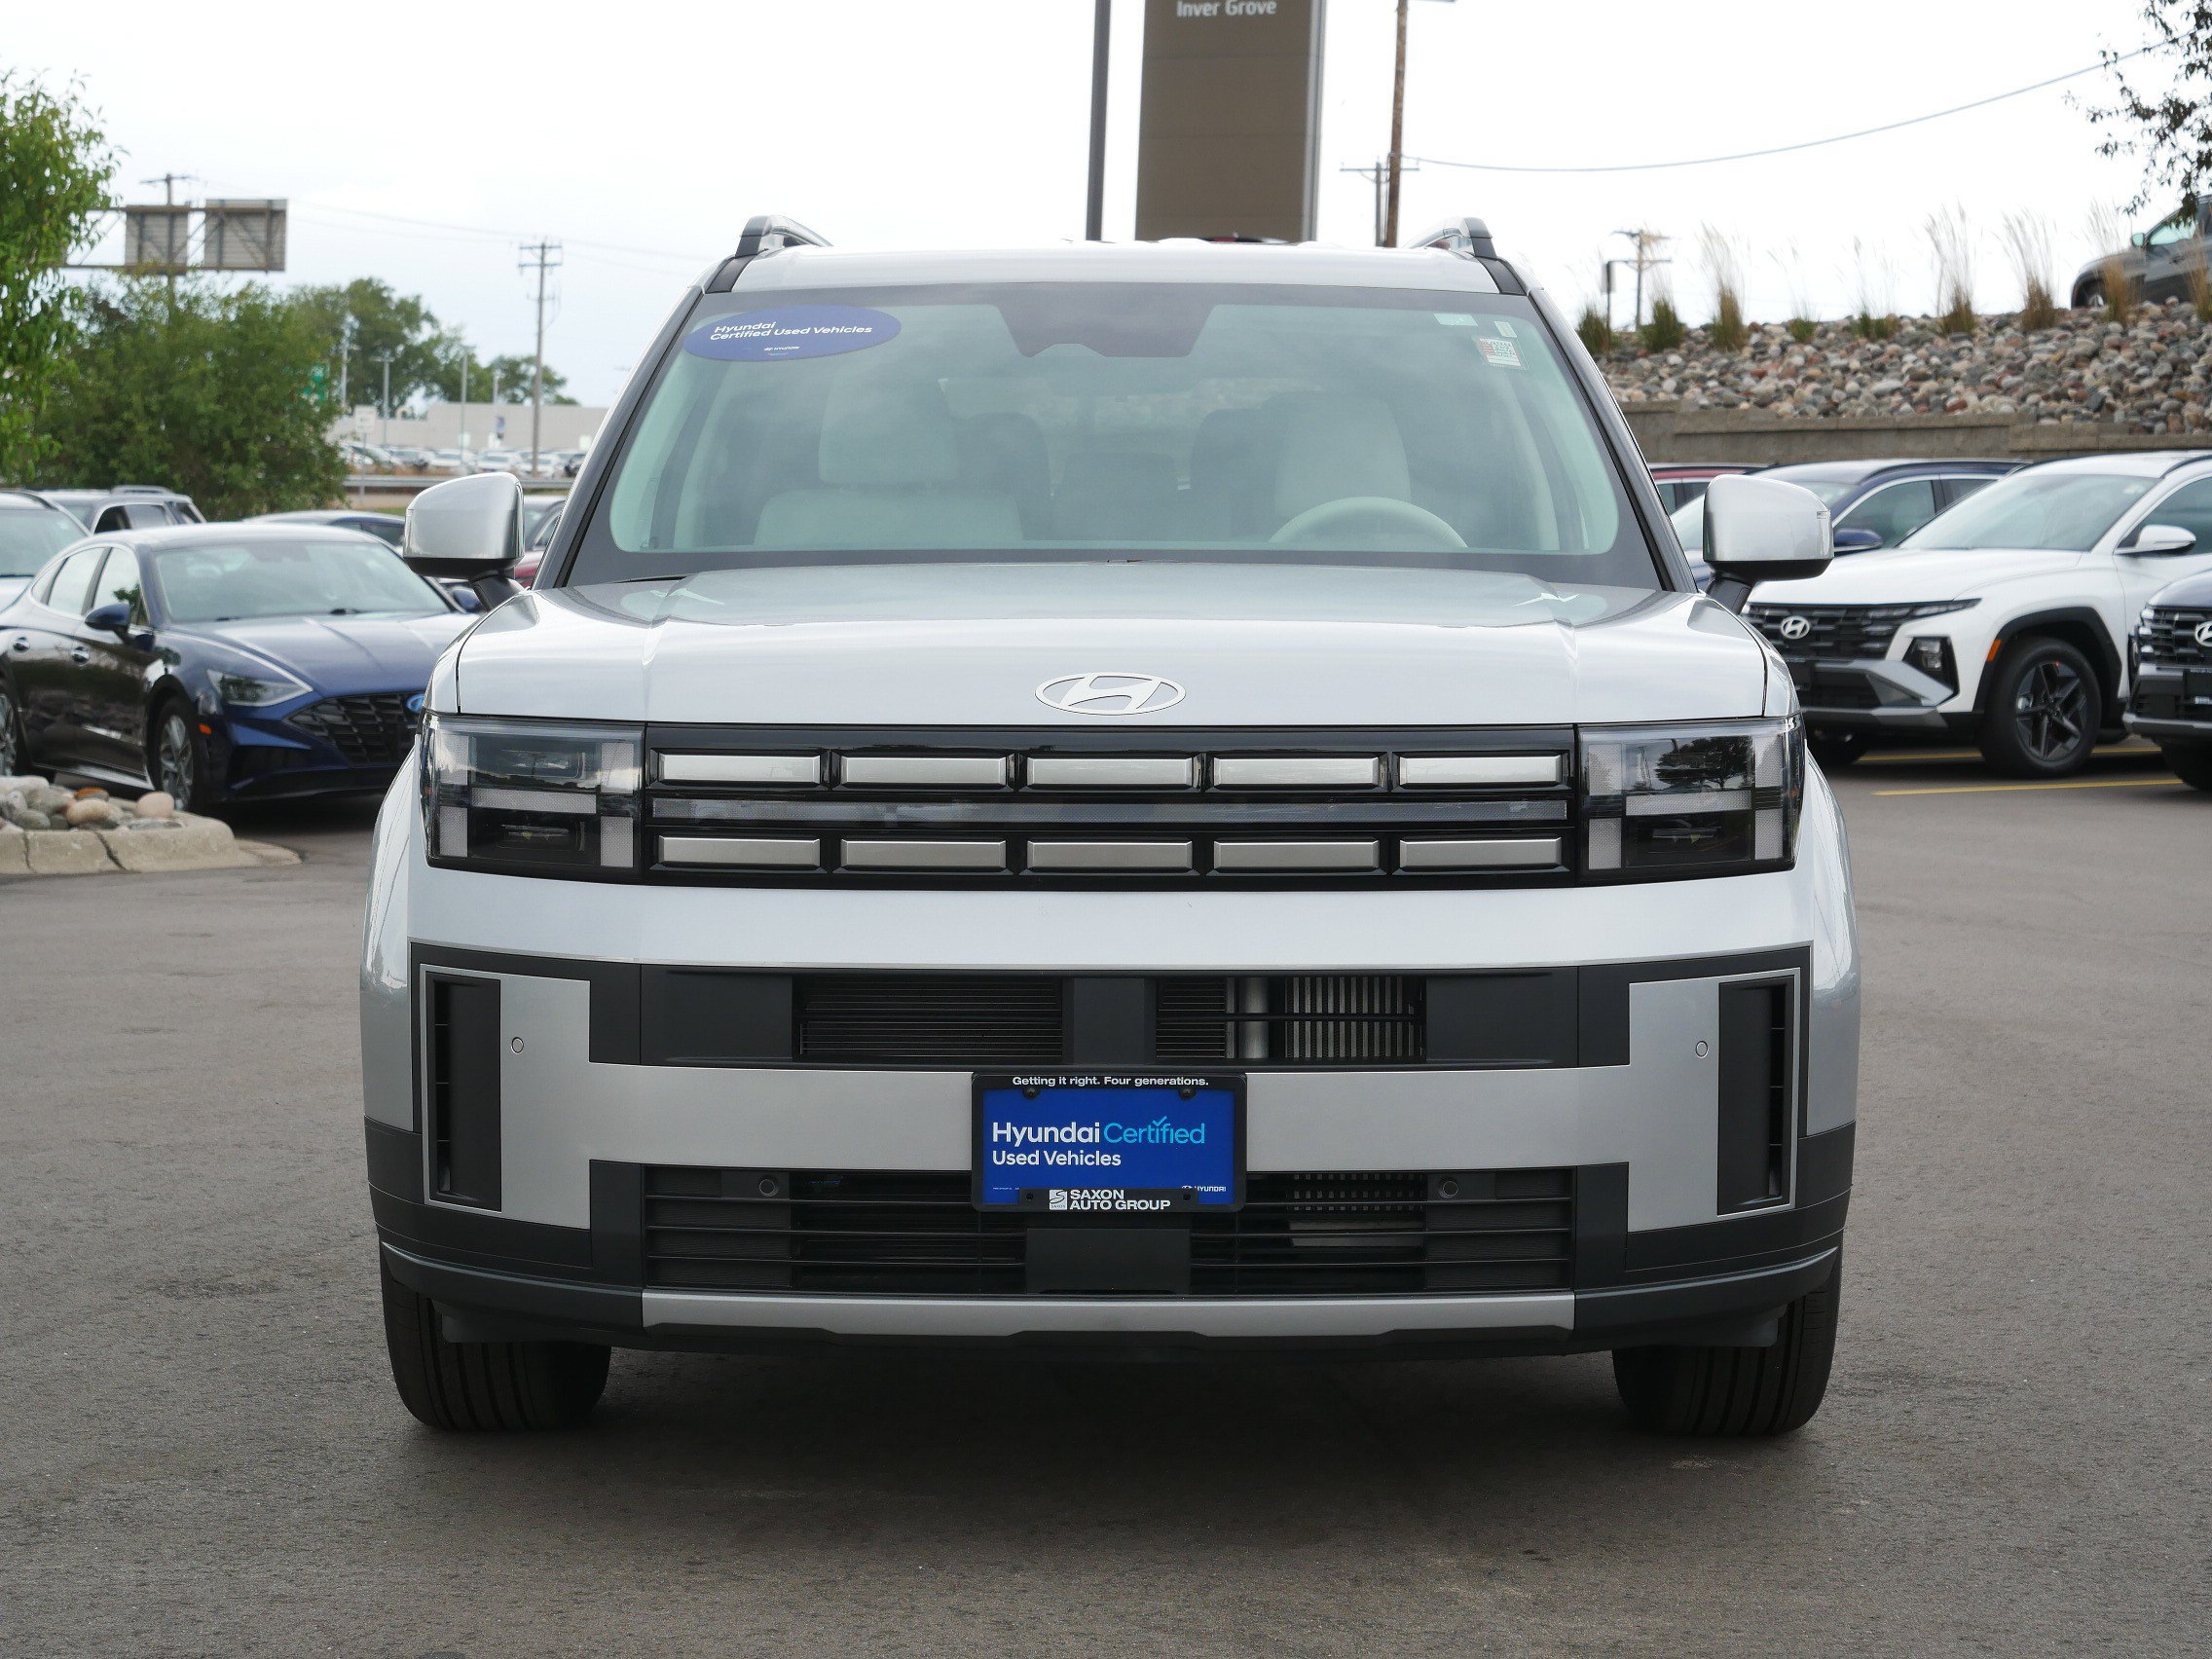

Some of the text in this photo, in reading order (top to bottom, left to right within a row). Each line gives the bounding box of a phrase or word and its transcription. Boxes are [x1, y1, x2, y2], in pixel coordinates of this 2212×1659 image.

[1176, 0, 1277, 17] Inver Grove
[710, 325, 873, 341] Certified Used Vehicles
[714, 321, 777, 333] Hyundai
[1013, 1076, 1209, 1087] Getting it right. Four generations.
[992, 1116, 1205, 1147] Hyundai Certified
[992, 1150, 1122, 1166] Used Vehicles
[1070, 1189, 1124, 1200] SAXON
[1069, 1199, 1171, 1211] AUTO GROUP
